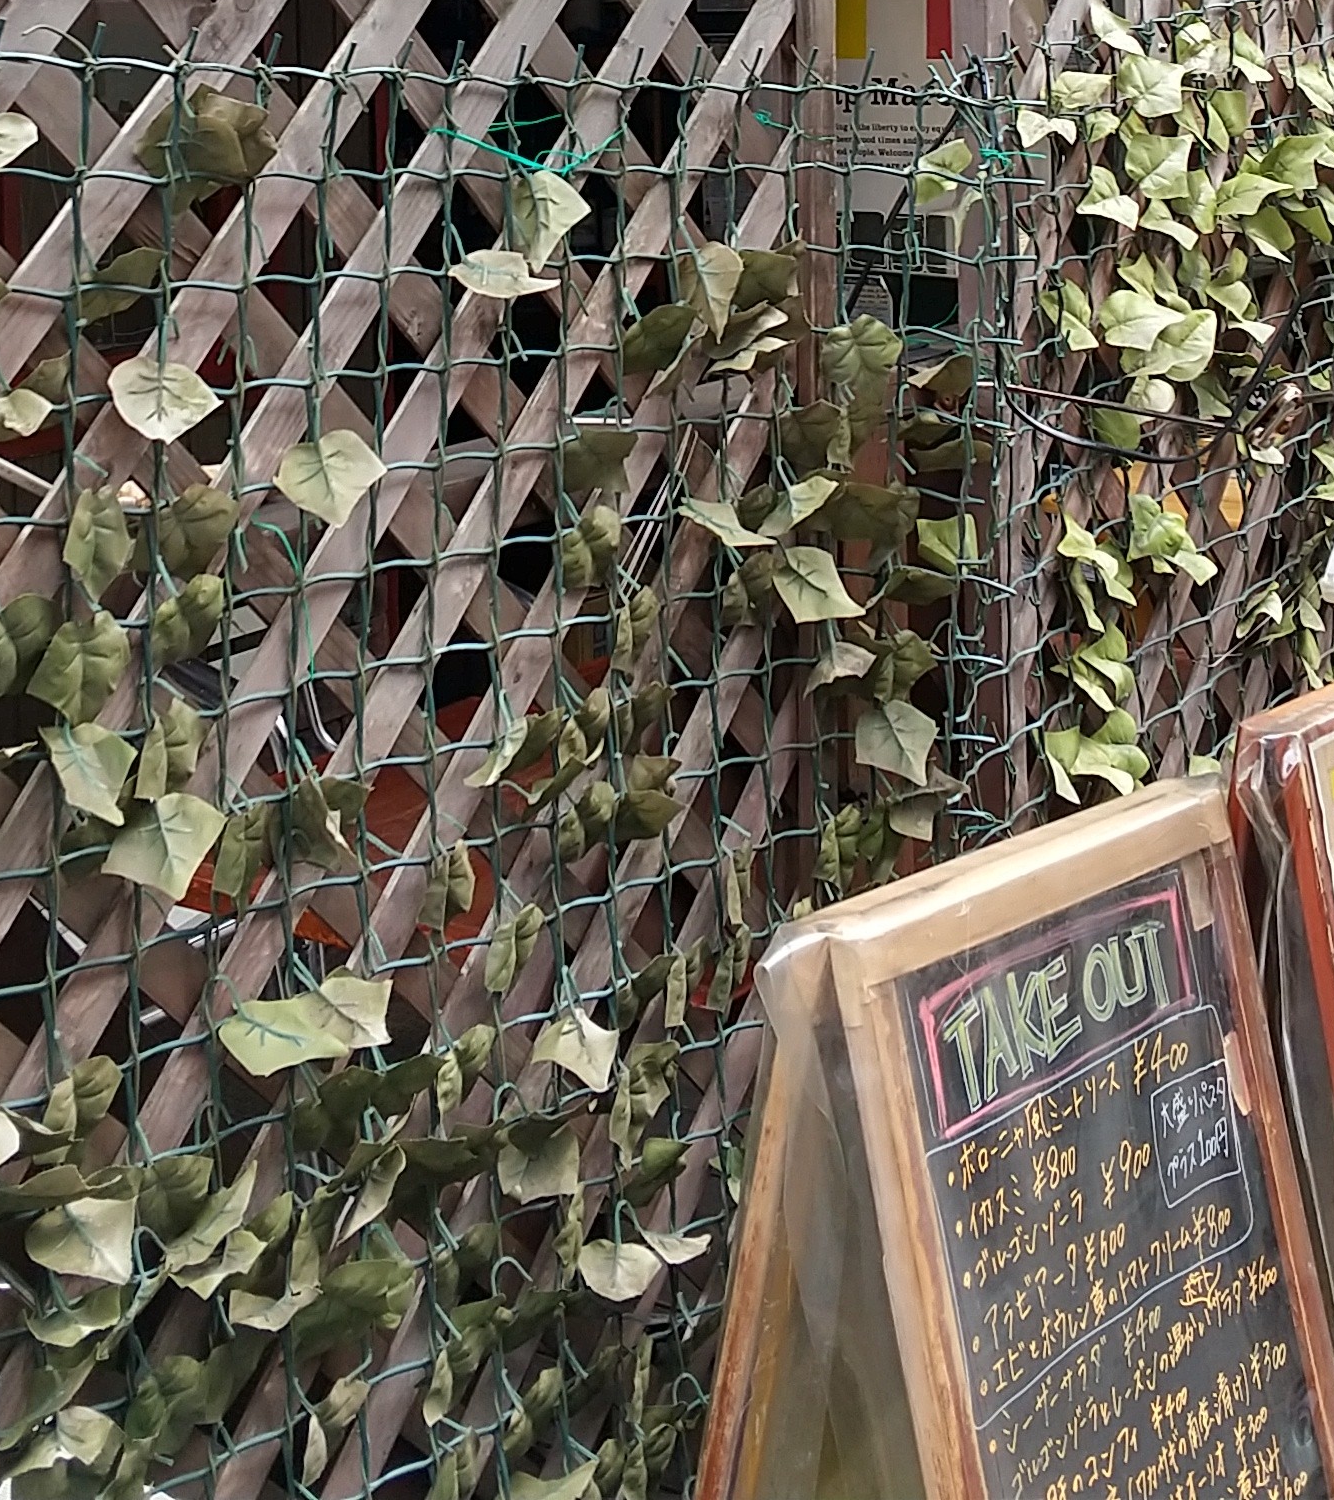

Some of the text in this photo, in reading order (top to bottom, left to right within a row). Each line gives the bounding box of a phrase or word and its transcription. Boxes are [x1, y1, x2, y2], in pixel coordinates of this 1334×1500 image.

[879, 148, 914, 157] Welcome
[942, 919, 1171, 1113] TAKE OUT
